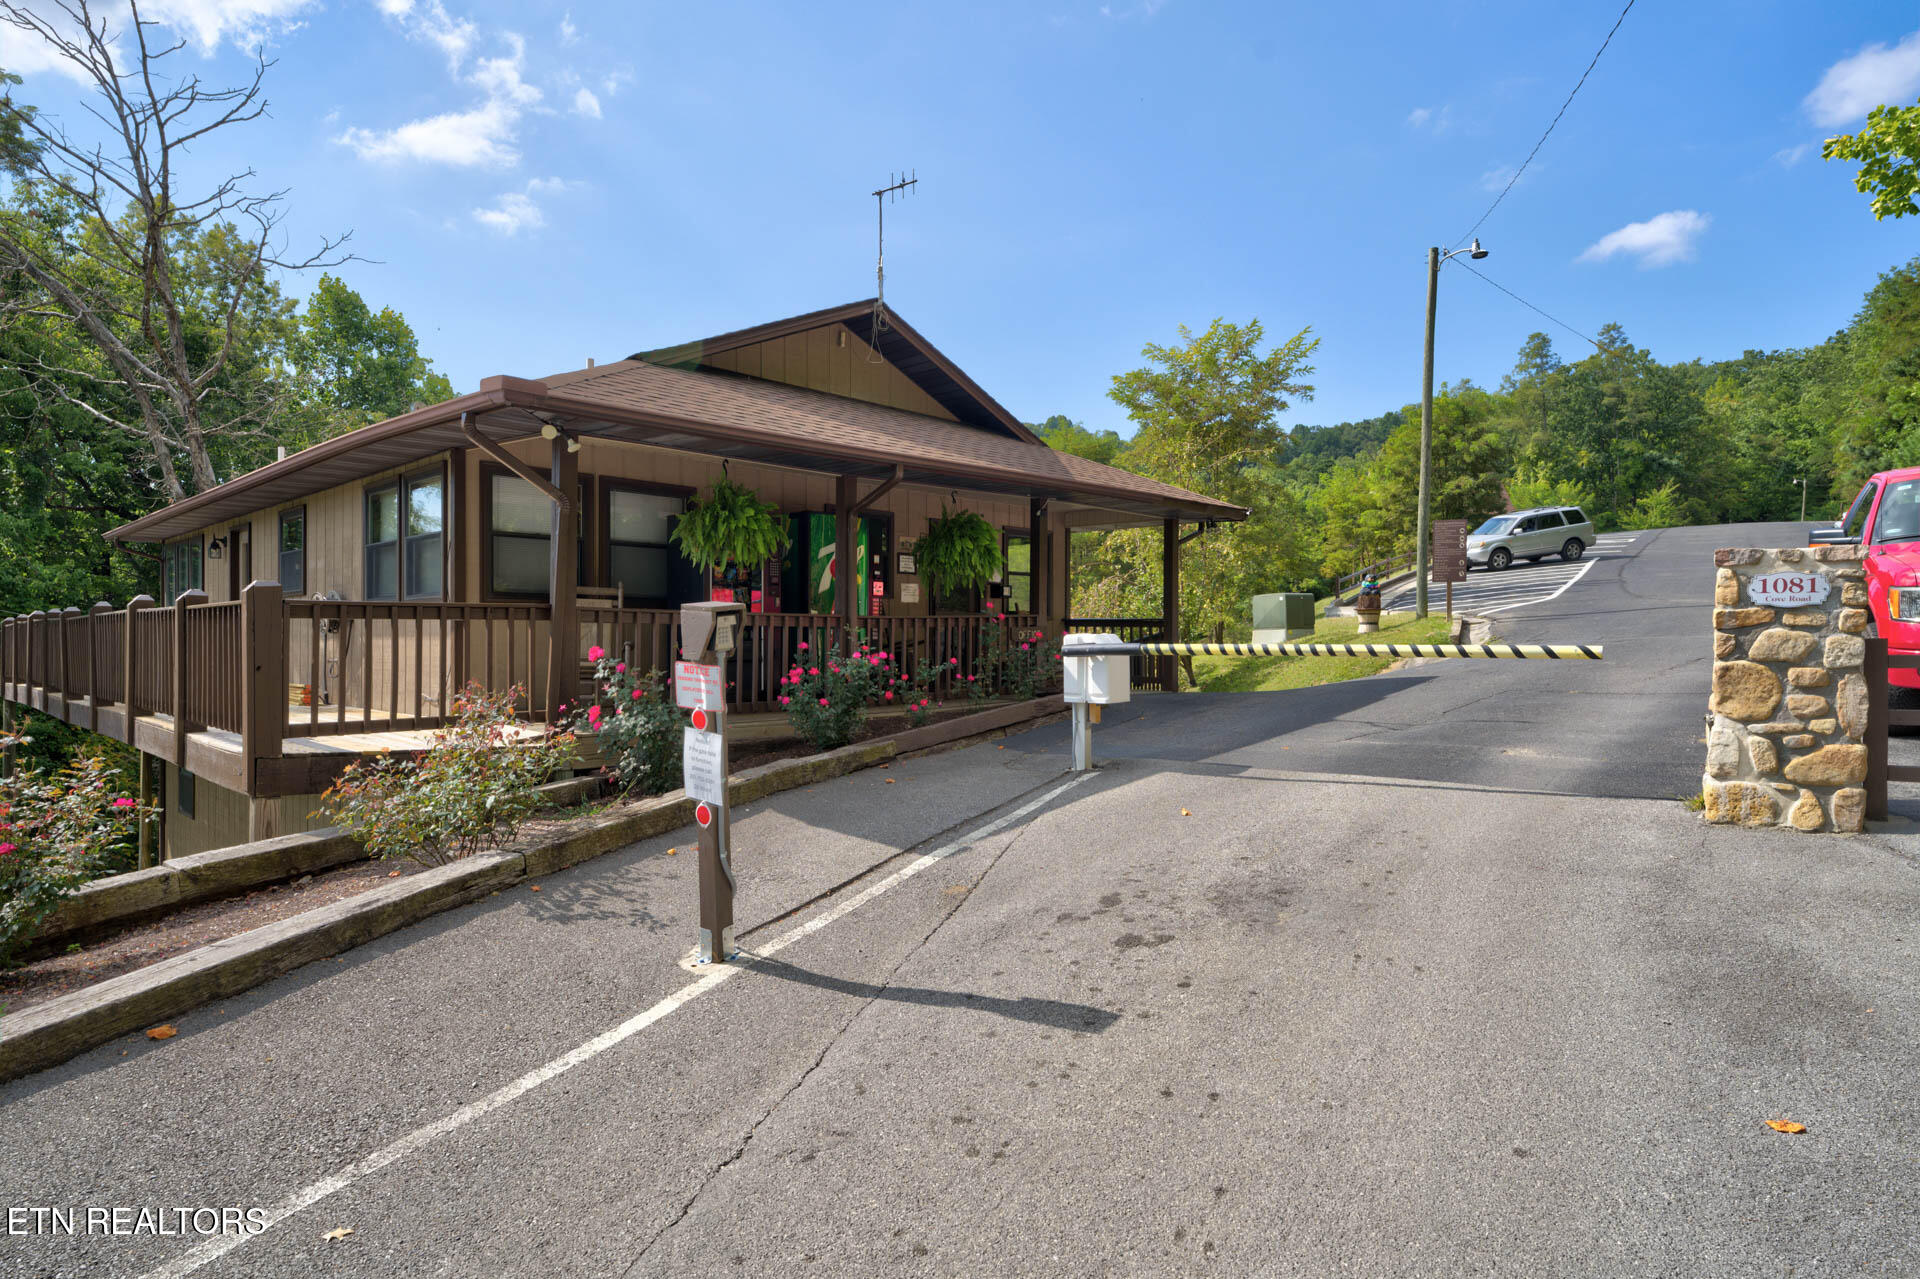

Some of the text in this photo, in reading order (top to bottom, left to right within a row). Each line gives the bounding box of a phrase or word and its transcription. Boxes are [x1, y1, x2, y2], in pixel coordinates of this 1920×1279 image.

[1758, 577, 1819, 594] 1081
[1765, 595, 1812, 603] Cove Road
